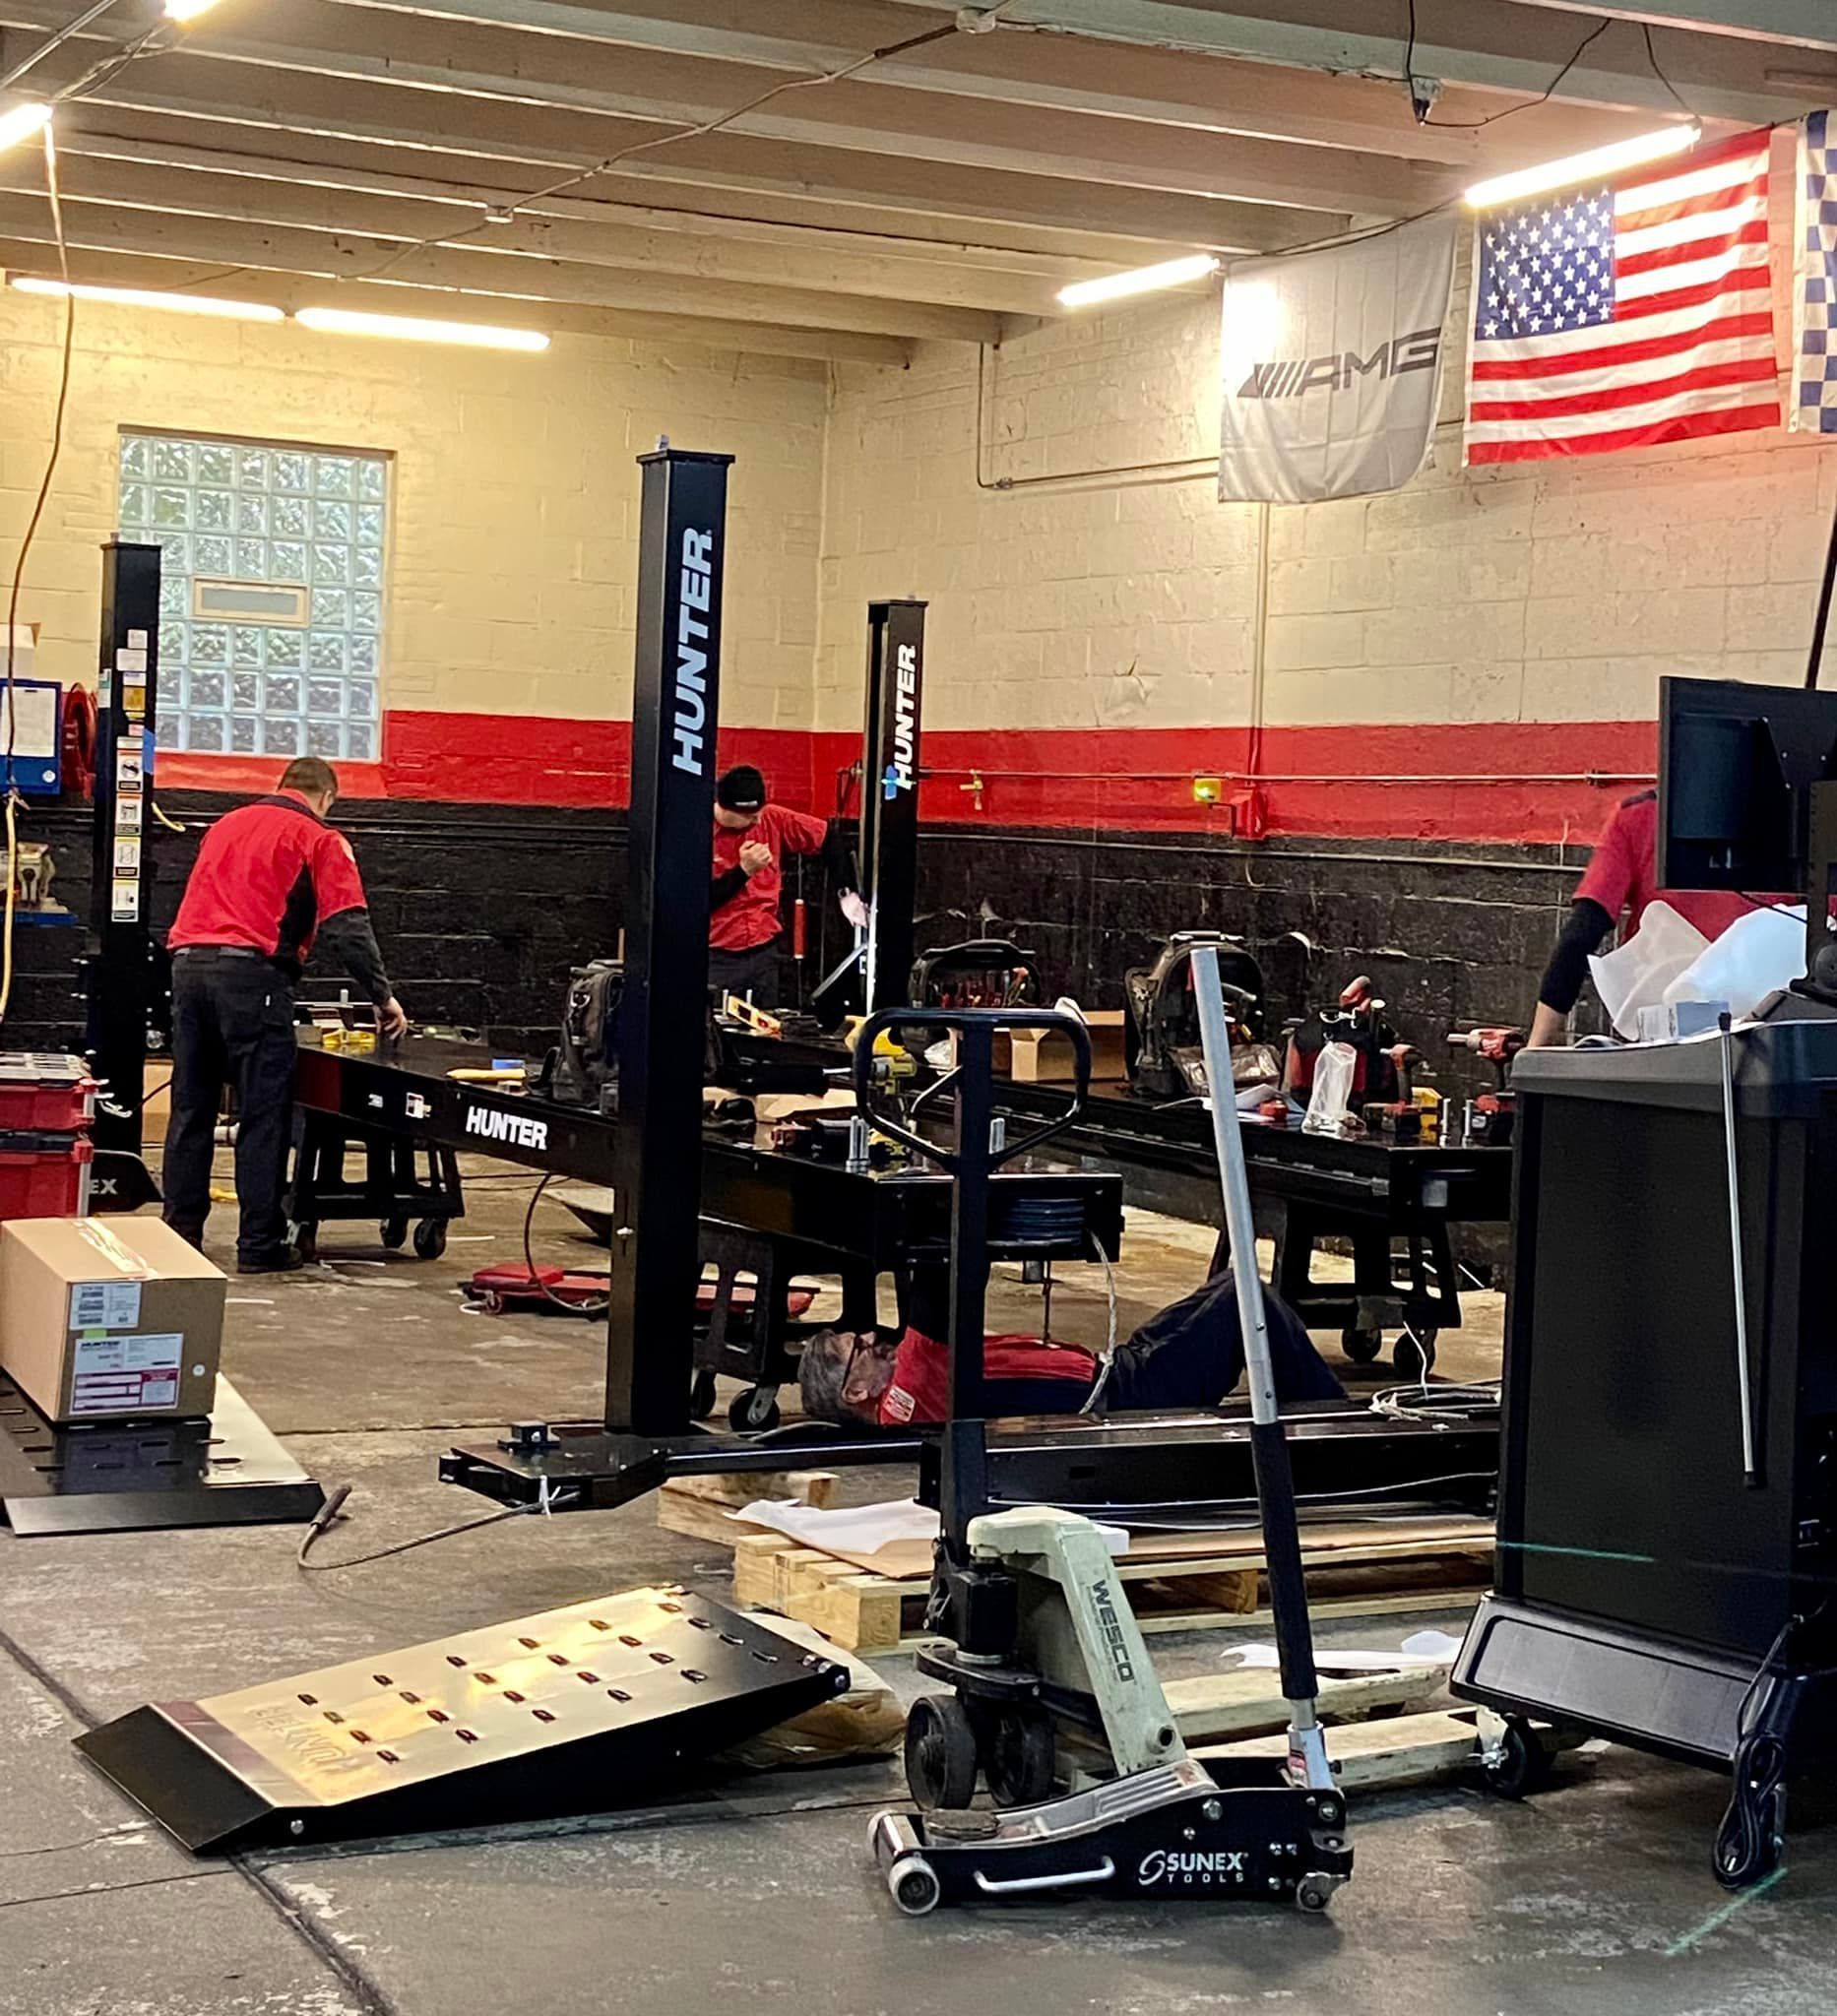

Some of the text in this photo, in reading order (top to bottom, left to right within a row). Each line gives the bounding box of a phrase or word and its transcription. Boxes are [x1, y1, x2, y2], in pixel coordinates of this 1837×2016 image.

[1295, 327, 1442, 398] AMG
[671, 527, 713, 777] HUNTER
[893, 644, 917, 790] HUNTER
[466, 1105, 547, 1151] HUNTER
[1093, 1579, 1135, 1682] WESCO
[1166, 1852, 1243, 1871] SUNEX
[1167, 1872, 1244, 1884] TOOLS
